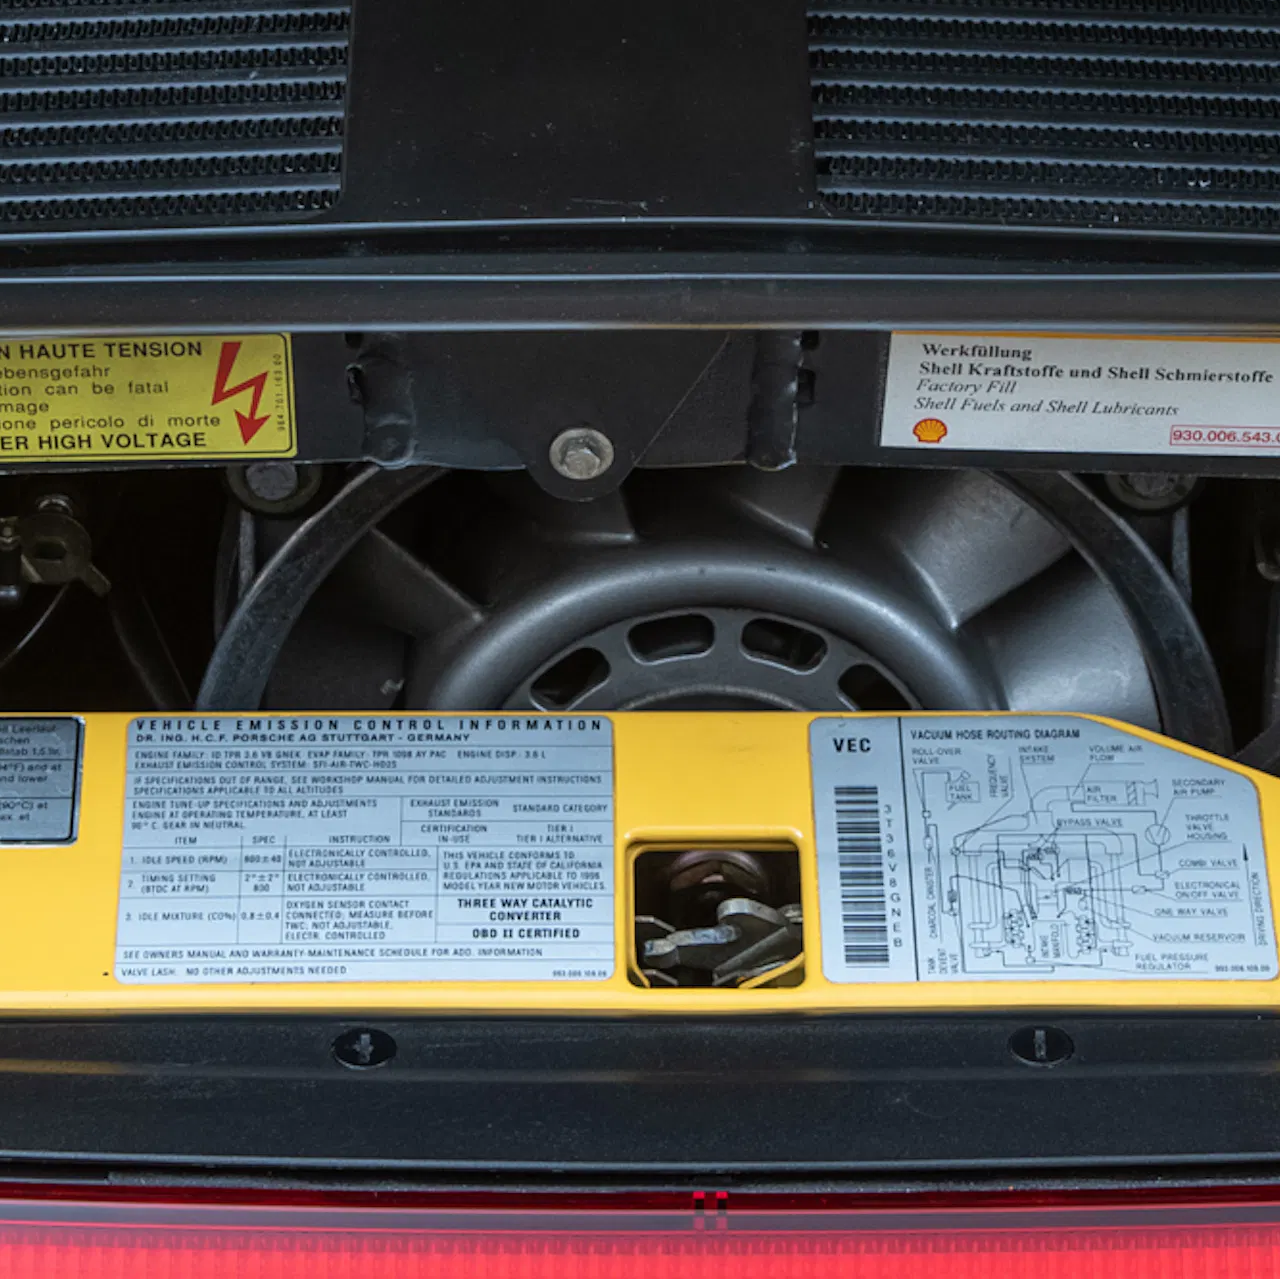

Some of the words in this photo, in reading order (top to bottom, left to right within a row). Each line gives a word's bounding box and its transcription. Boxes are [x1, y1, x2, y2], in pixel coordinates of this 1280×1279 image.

[19, 343, 96, 360] HAUTE
[102, 341, 202, 359] TENSION
[921, 343, 1032, 360] Werkfüllung
[919, 362, 963, 376] Shell
[967, 363, 1064, 379] Kraftstoffe
[1069, 366, 1102, 380] und
[1107, 367, 1150, 381] Shell
[1154, 368, 1273, 383] Schmierstoffe
[44, 386, 78, 396] can
[91, 383, 114, 395] be
[127, 382, 168, 394] fatal
[915, 379, 982, 399] Factory
[985, 380, 1018, 395] Fill
[913, 397, 957, 411] Shell
[959, 398, 1006, 413] Fuels
[1009, 399, 1044, 413] and
[1044, 400, 1088, 414] Shell
[1091, 400, 1180, 416] Lubricants
[49, 416, 125, 434] pericolo
[137, 415, 154, 429] di
[167, 416, 220, 428] morte
[37, 434, 92, 451] HIGH
[100, 432, 206, 449] VOLTAGE
[136, 720, 220, 730] VEHICLE
[236, 720, 339, 730] EMISSION
[353, 720, 444, 730] CONTROL
[458, 720, 600, 730] INFORMATION
[232, 734, 295, 742] PORSCHE
[298, 734, 317, 742] AG
[321, 734, 394, 742] STUTTGART
[406, 734, 470, 742] GERMANY
[910, 730, 952, 739] VACUUM
[955, 730, 983, 739] HOSE
[986, 729, 1031, 739] ROUTING
[1033, 729, 1080, 739] DIAGRAM
[832, 738, 871, 752] VEC
[420, 824, 487, 832] CERTIFICATION
[443, 851, 464, 859] THIS
[466, 851, 505, 859] VEHICLE
[507, 851, 561, 859] CONFORMS
[563, 851, 575, 859] TO
[457, 898, 496, 908] THREE
[499, 898, 528, 908] WAY
[531, 898, 593, 908] CATALYTIC
[489, 912, 561, 921] CONVERTER
[472, 929, 497, 938] OBD
[502, 929, 513, 938] II
[517, 928, 580, 938] CERTIFIED
